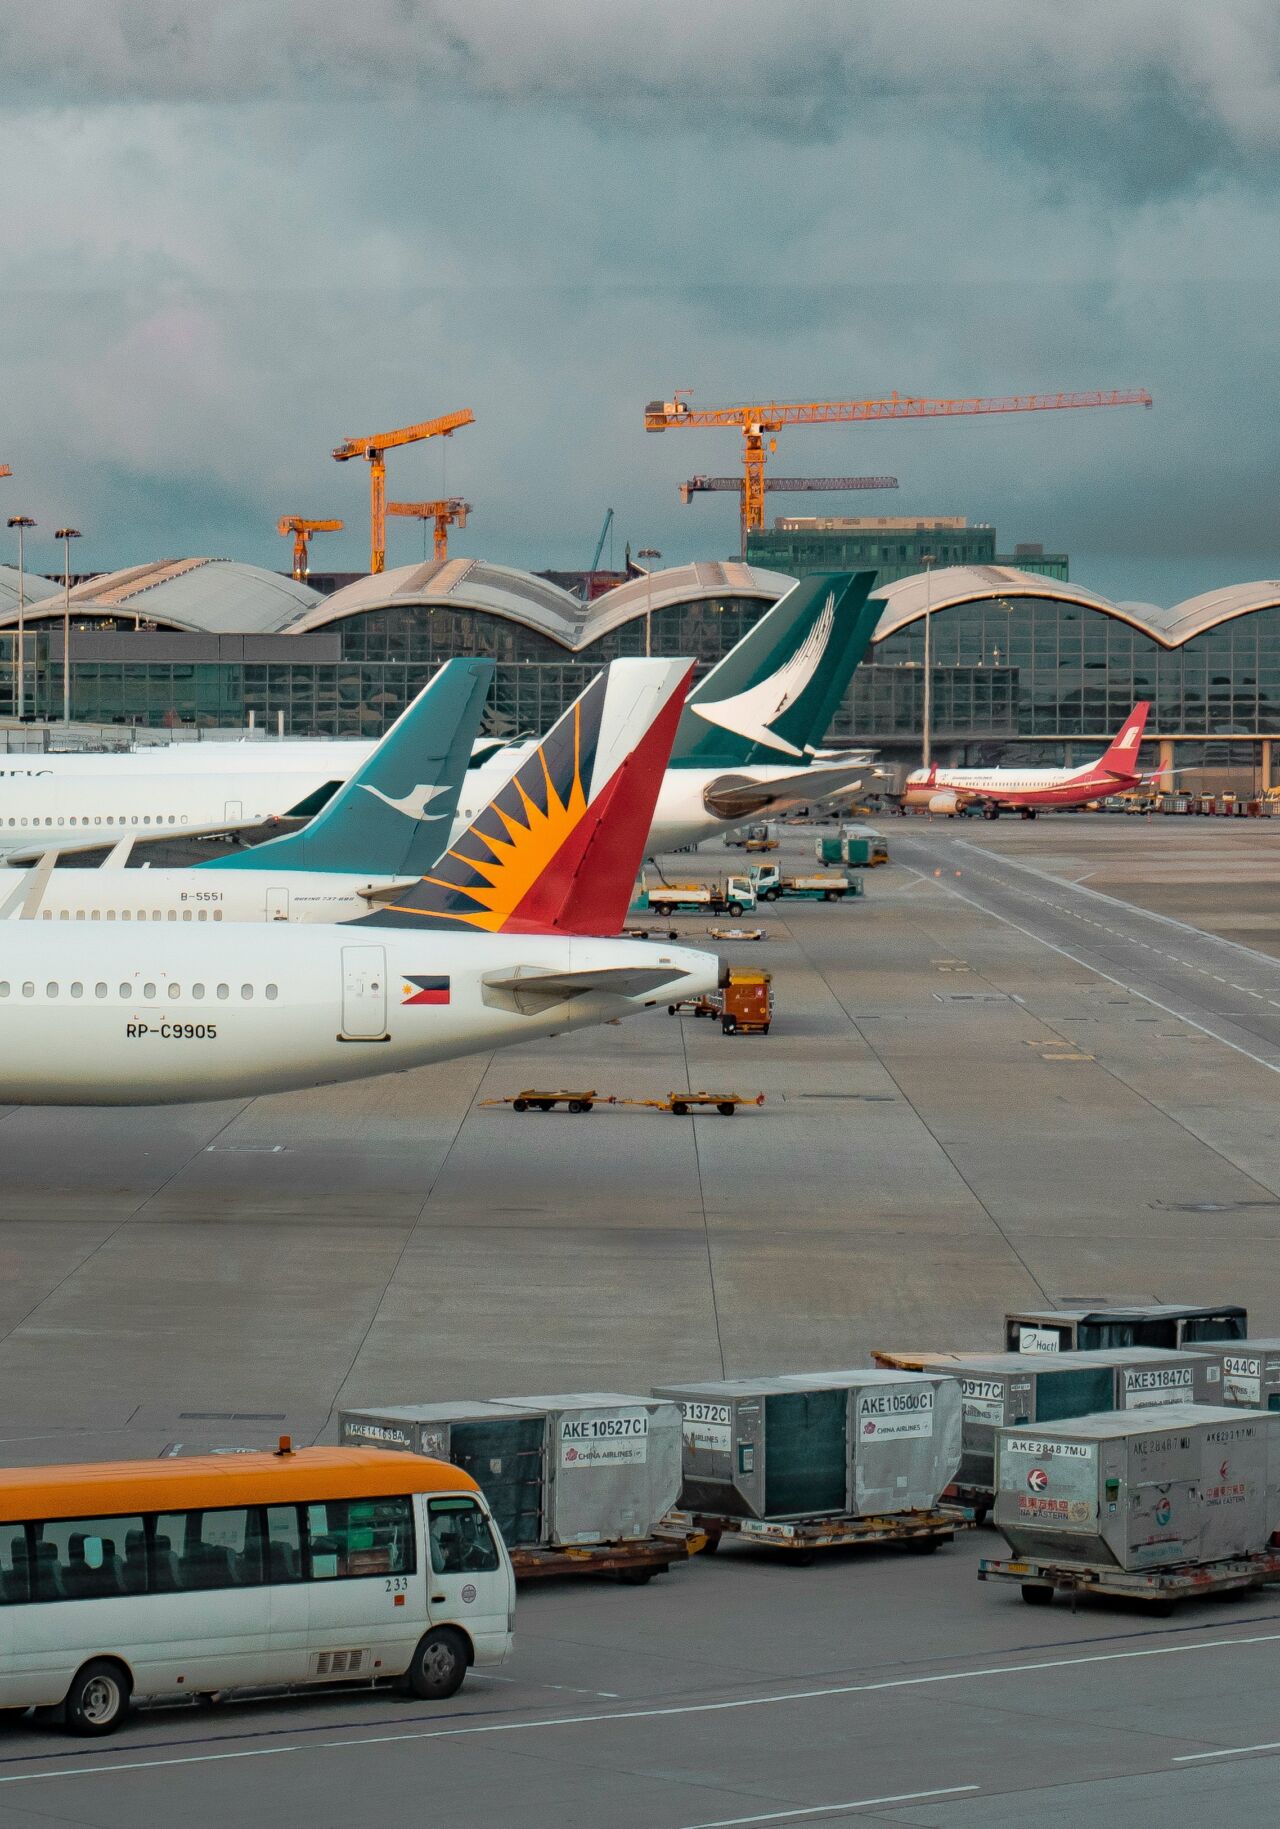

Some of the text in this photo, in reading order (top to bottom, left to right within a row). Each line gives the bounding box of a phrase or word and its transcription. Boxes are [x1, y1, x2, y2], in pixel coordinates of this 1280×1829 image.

[181, 892, 223, 901] B-5551
[126, 1023, 217, 1039] RP-C9905
[1127, 1369, 1193, 1388] AKE31847CI
[562, 1418, 648, 1438] AKE10527CI
[578, 1449, 633, 1461] CHINA AIRLINES
[385, 1577, 408, 1592] 233
